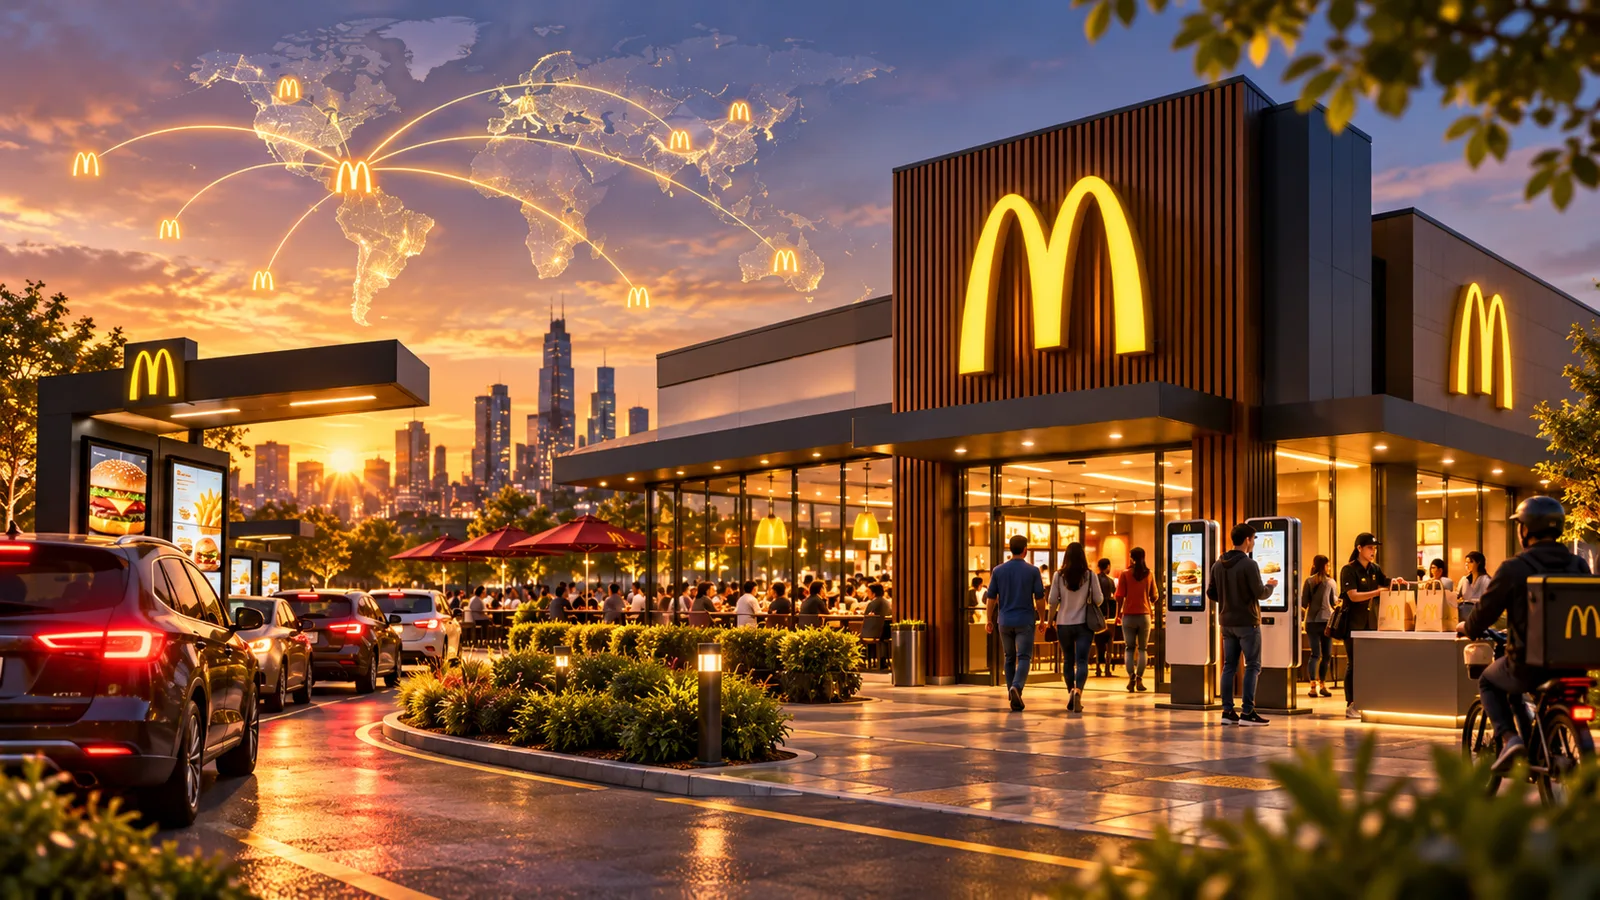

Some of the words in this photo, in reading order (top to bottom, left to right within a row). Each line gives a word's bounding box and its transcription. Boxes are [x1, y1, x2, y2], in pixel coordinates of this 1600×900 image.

[959, 175, 1154, 376] M
[1450, 282, 1513, 410] M
[129, 348, 176, 400] M
[1183, 524, 1191, 532] M
[1264, 521, 1272, 529] M
[1565, 605, 1600, 639] M
